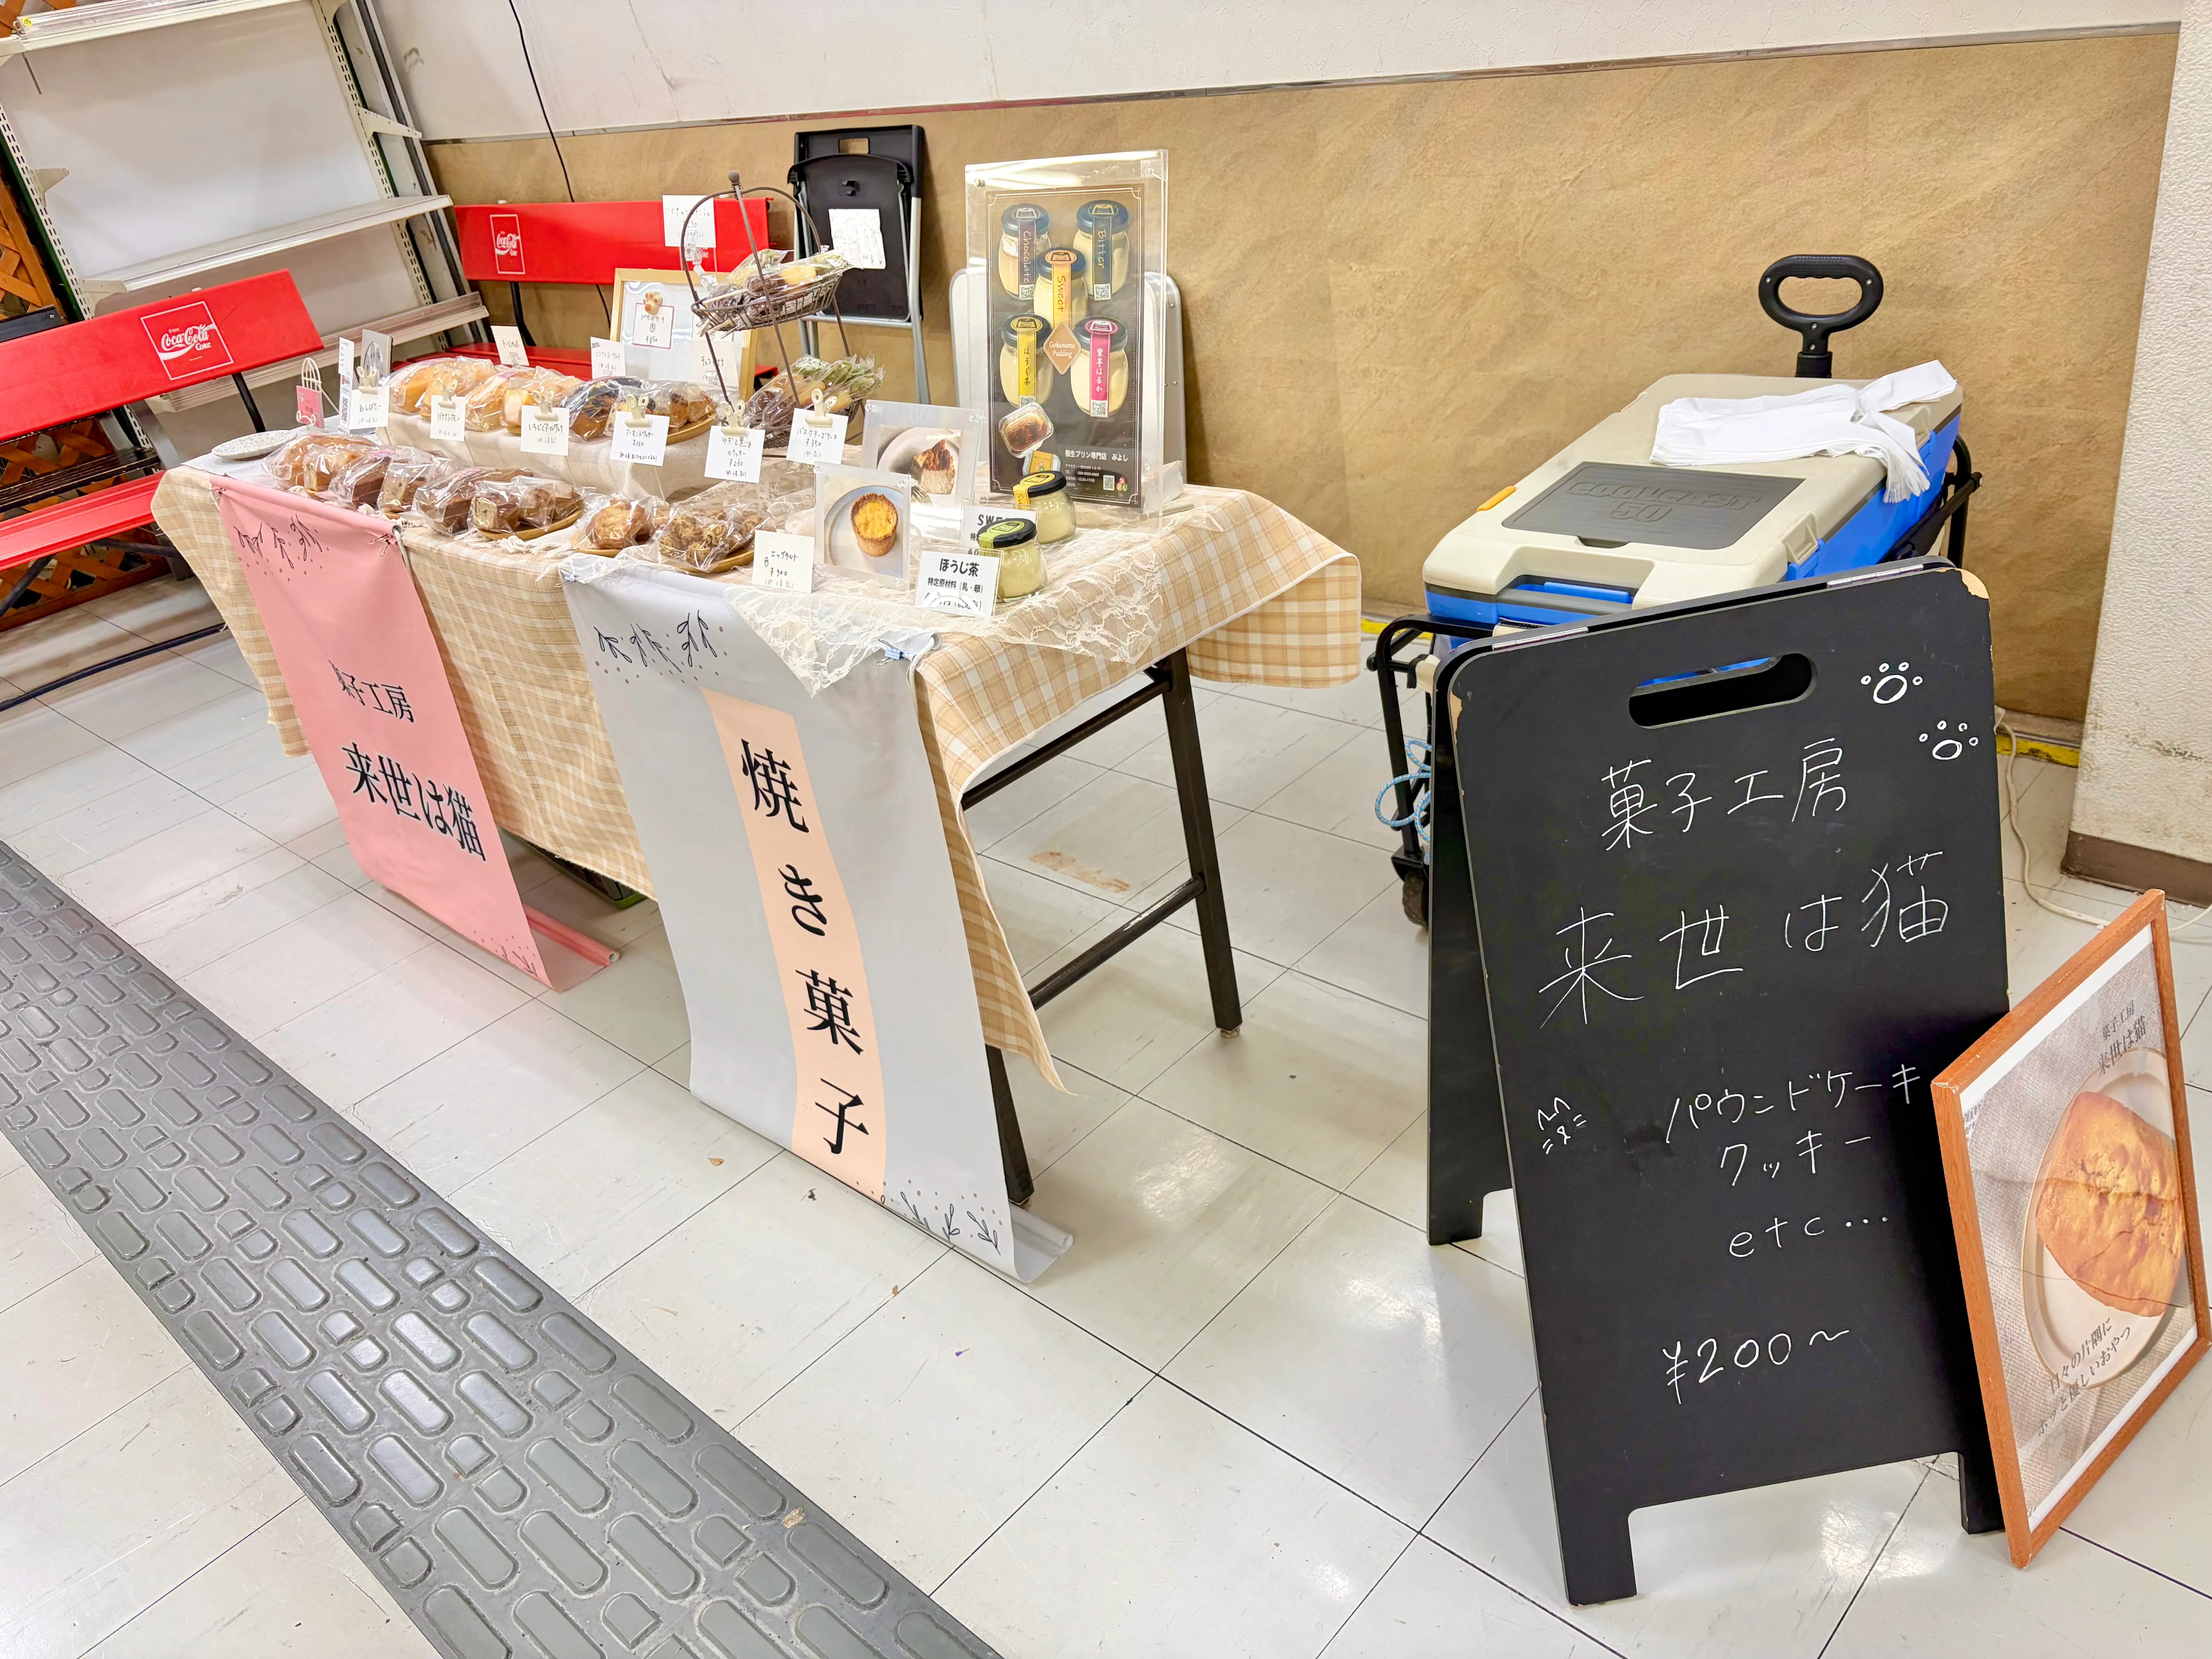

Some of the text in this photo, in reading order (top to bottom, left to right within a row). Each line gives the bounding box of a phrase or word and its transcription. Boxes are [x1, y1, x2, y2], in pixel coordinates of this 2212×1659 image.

[1097, 228, 1106, 269] Bitter
[1057, 275, 1065, 313] Sweet
[161, 323, 209, 351] Coca-Cola
[195, 342, 212, 351] Coke
[1052, 350, 1072, 359] Pudding
[1065, 450, 1128, 462] 極生プリン専門店 みよし
[1609, 501, 1673, 522] 50
[939, 558, 980, 577] ほうじ茶
[342, 742, 486, 862] 来世は猫
[1601, 737, 1846, 851] 菓子工房
[741, 738, 869, 1155] 焼き菓子
[1539, 851, 1949, 1029] 来世は猫
[2102, 1000, 2135, 1042] 菓子工房
[2098, 1015, 2146, 1078] 来世は猫
[1666, 1063, 1920, 1144] パウンドケーキ
[1720, 1130, 1872, 1186] クッキー
[2051, 1317, 2112, 1394] 日々の片隅に
[2039, 1327, 2130, 1436] ホッと優しいおやつ
